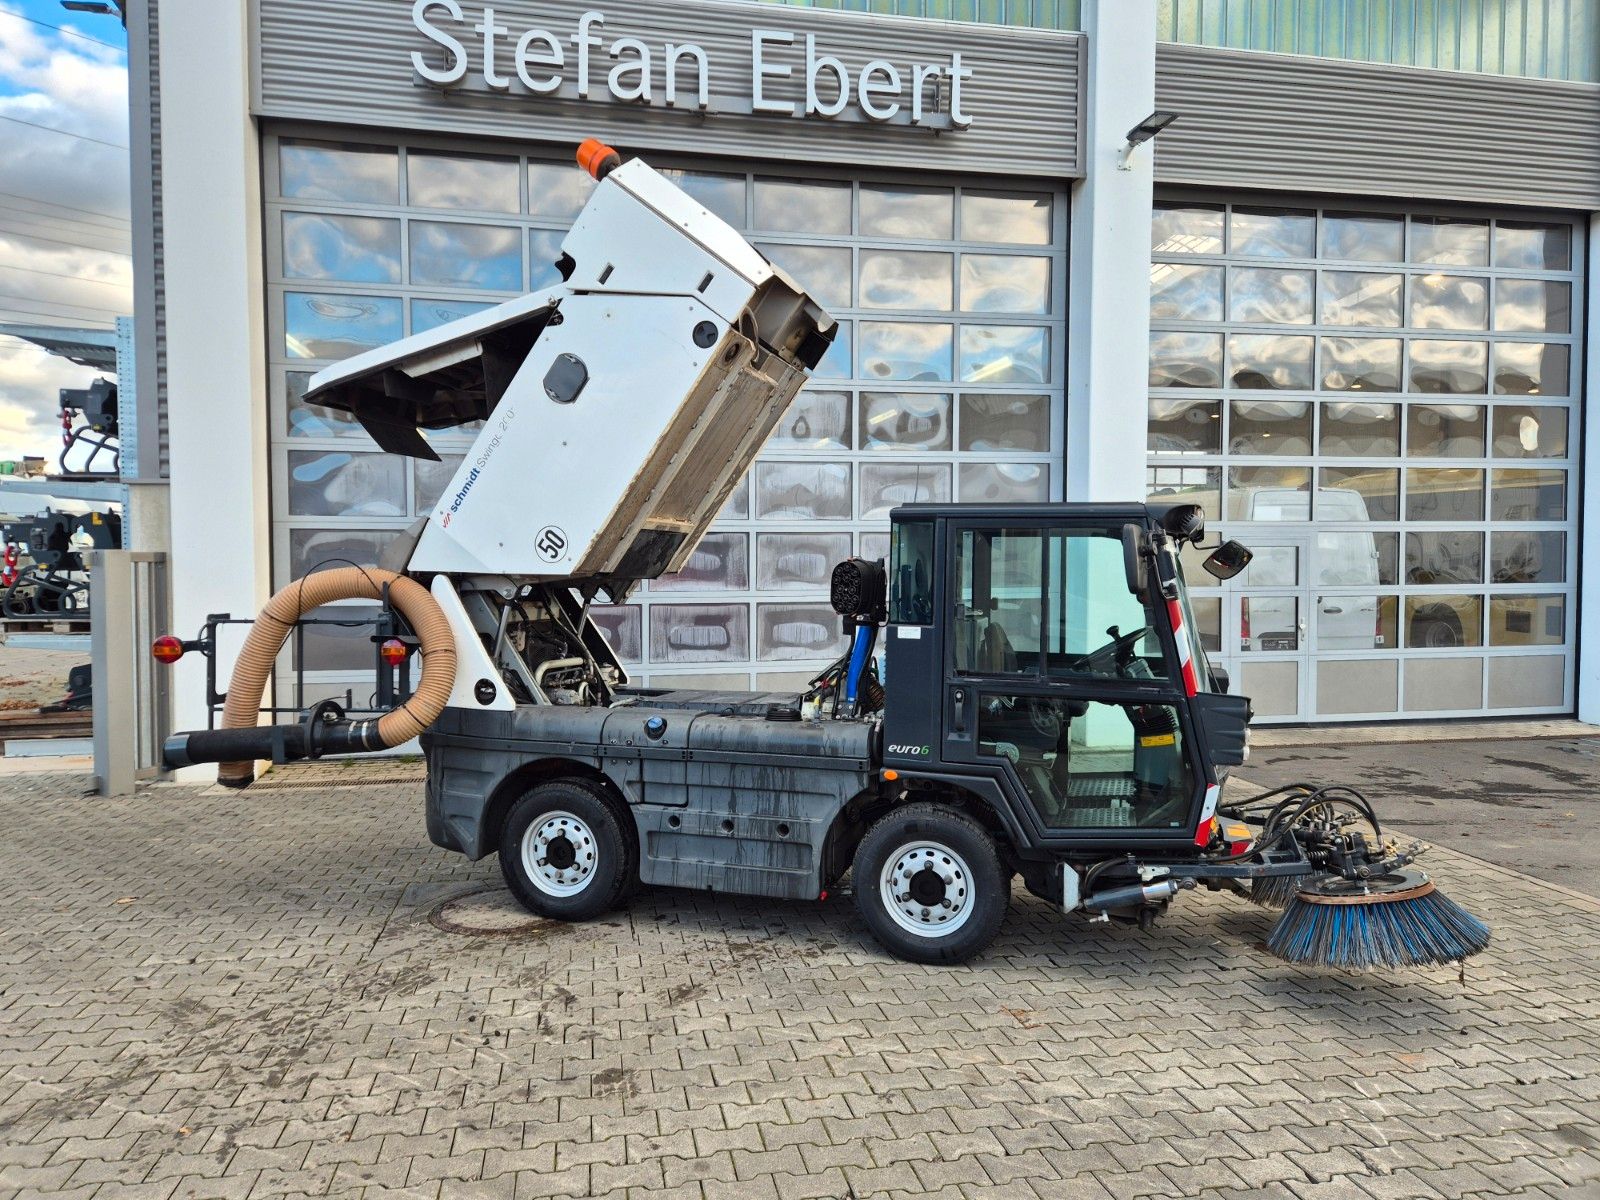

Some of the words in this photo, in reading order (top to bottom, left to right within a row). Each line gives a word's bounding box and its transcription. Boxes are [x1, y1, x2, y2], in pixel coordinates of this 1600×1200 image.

[410, 0, 709, 109] Stefan
[751, 29, 973, 131] Ebert
[450, 467, 481, 513] schmidt
[537, 529, 565, 559] 50
[888, 744, 931, 755] euro6
